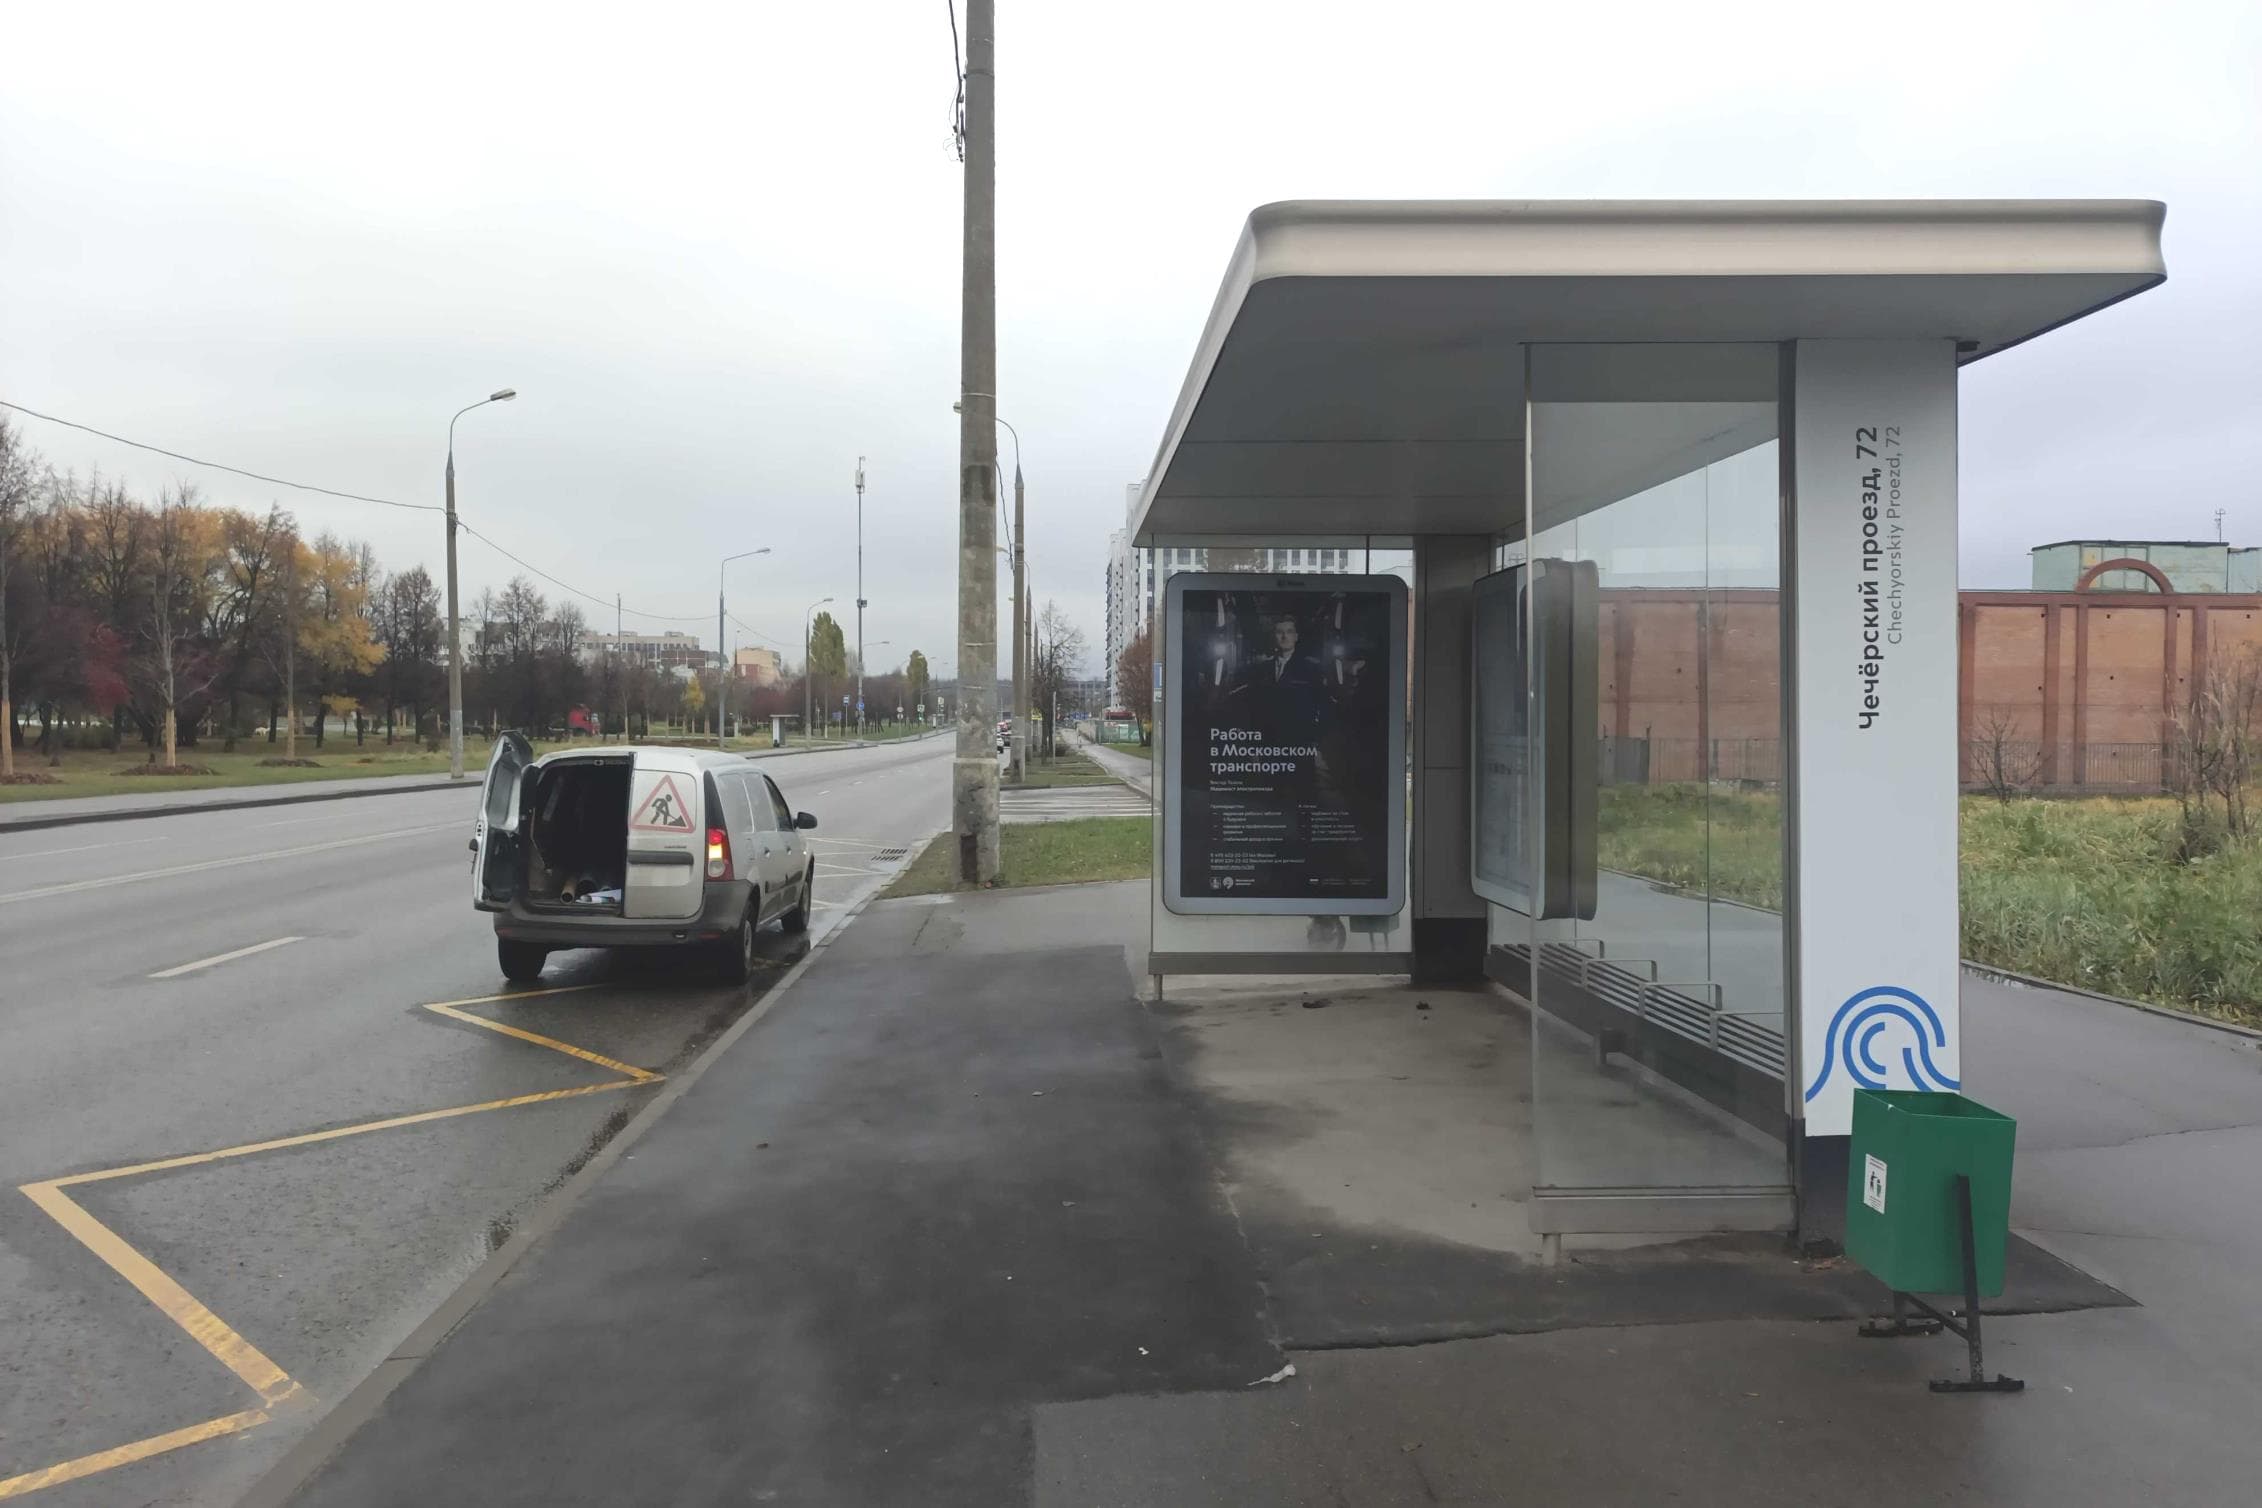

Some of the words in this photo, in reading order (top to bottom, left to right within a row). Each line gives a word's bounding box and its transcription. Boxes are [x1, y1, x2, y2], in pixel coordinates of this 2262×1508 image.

[1856, 427, 1878, 459] 72
[1885, 425, 1901, 447] 72
[1886, 453, 1902, 519] Proezd,
[1860, 467, 1883, 572] проезд,
[1886, 524, 1904, 645] Chechyorskiy
[1858, 581, 1884, 729] Чечёрский
[1210, 728, 1262, 741] Работа
[1210, 746, 1219, 757] в
[1222, 744, 1318, 757] Московском
[1210, 762, 1296, 775] транспорте
